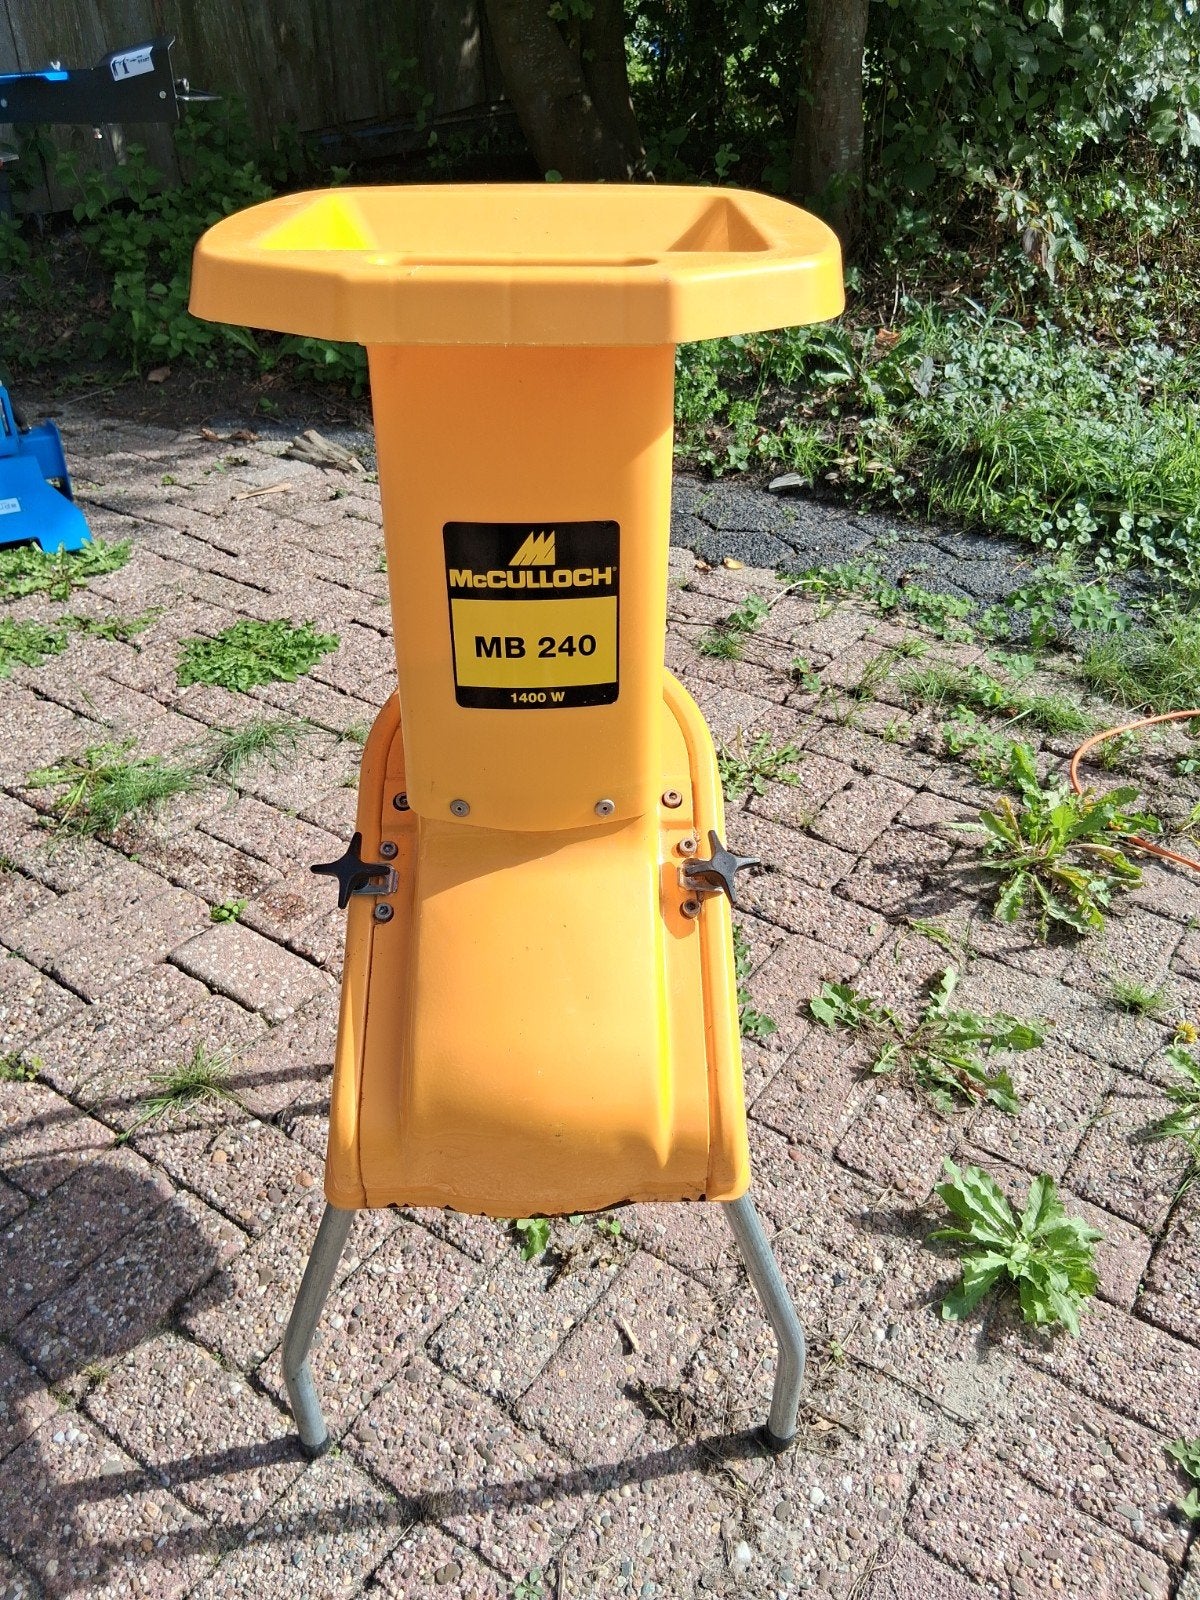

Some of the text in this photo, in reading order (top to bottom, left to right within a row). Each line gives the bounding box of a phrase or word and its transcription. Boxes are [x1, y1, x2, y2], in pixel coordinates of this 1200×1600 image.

[449, 566, 612, 589] McCULLOCH
[474, 634, 597, 659] MB 240
[510, 691, 565, 703] 1400 W
